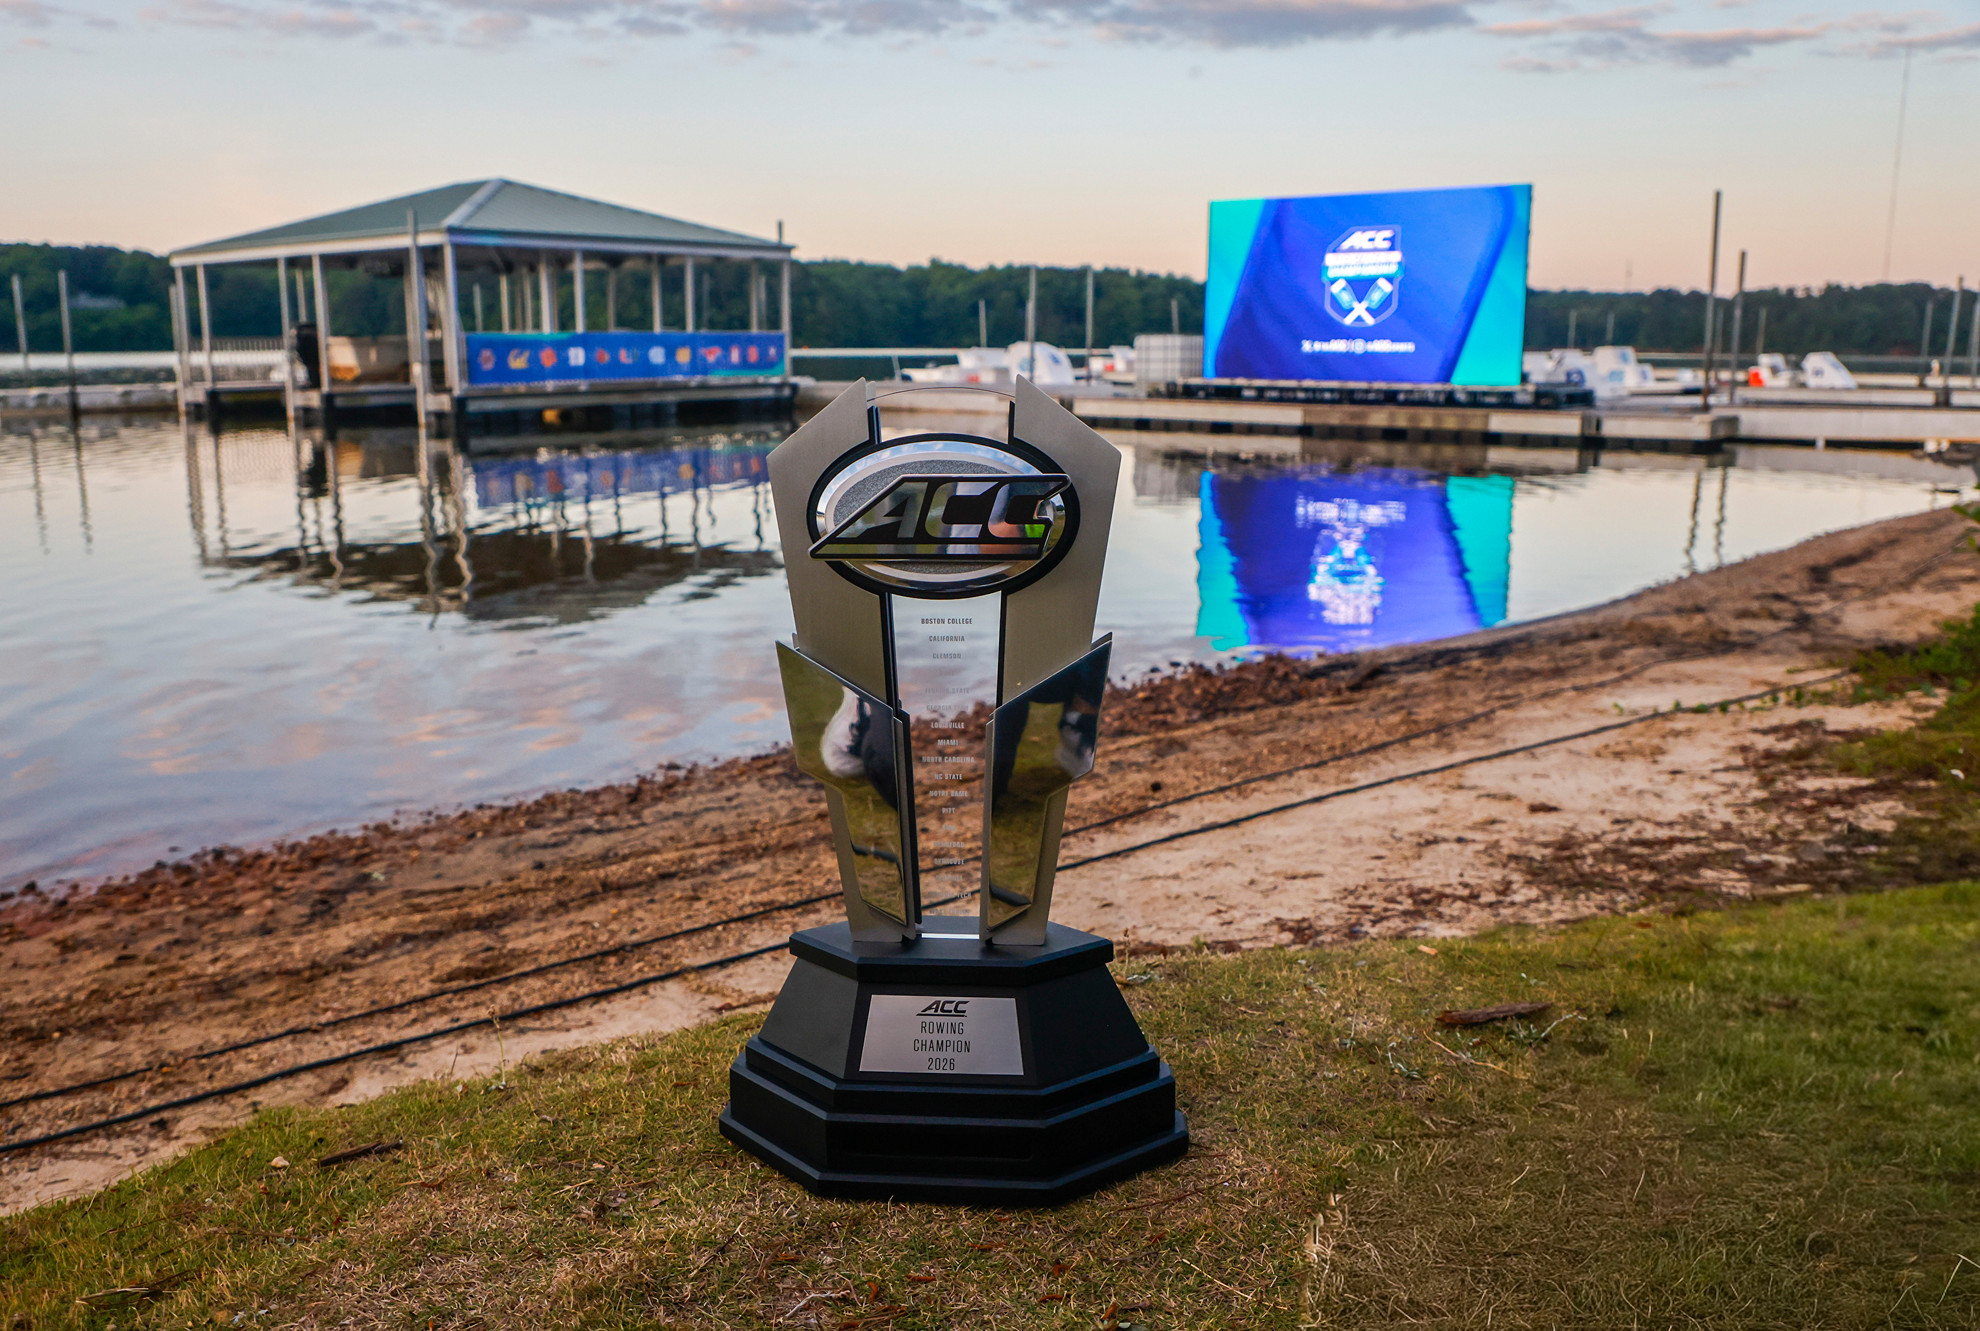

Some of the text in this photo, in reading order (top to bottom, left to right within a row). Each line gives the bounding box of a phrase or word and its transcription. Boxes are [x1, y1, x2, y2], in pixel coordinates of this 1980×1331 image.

[1339, 229, 1395, 250] ACC
[834, 481, 1064, 539] ACC
[920, 1000, 970, 1014] ACC
[920, 1021, 964, 1035] ROWING
[913, 1039, 971, 1053] CHAMPION
[927, 1058, 955, 1071] 2026
